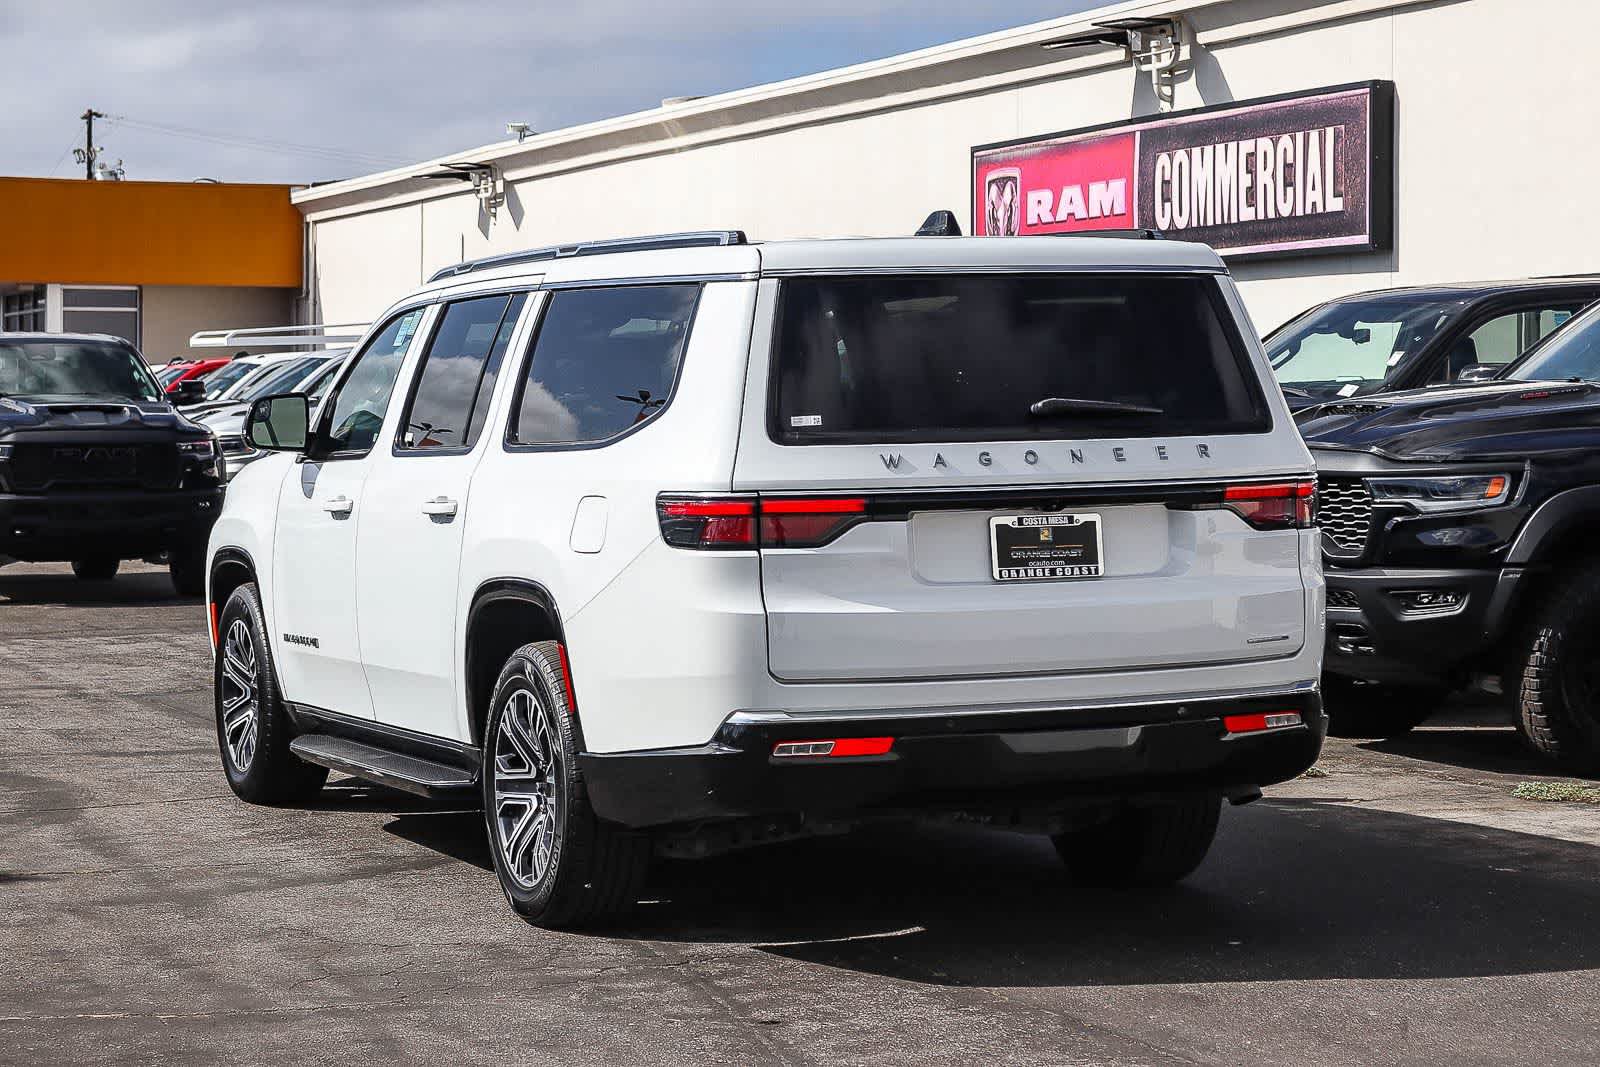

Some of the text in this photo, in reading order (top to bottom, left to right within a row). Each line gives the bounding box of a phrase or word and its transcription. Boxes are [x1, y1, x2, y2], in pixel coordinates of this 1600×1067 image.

[1026, 125, 1345, 231] RAM COMMERCIAL
[880, 443, 1211, 469] WAGONEER
[1022, 515, 1069, 526] COSTA MESA
[1001, 566, 1097, 578] ORANGE COAST
